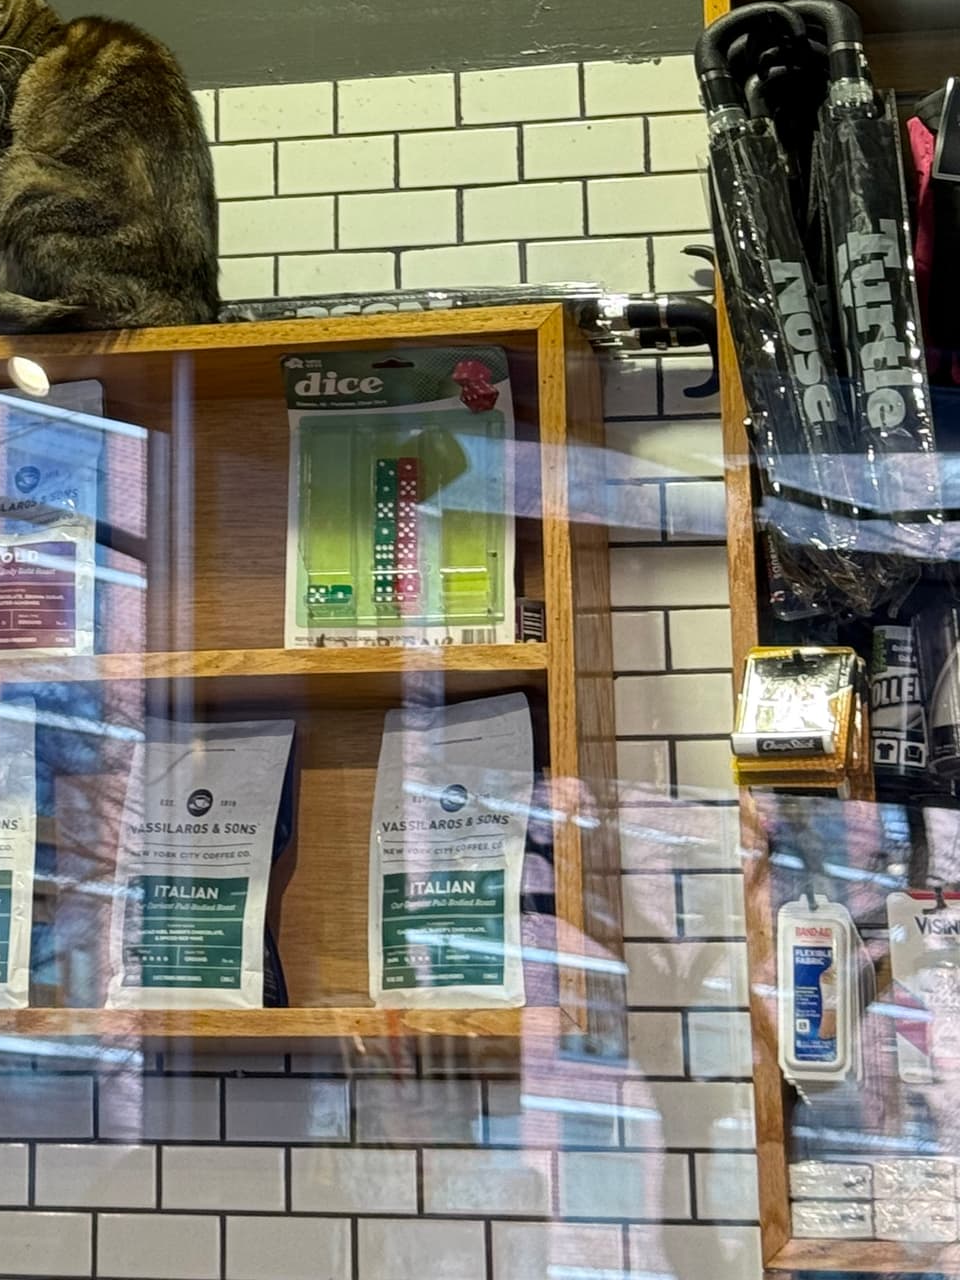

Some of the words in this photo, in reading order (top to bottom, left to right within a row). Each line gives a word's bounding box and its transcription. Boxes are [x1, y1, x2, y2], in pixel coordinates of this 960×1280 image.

[294, 371, 384, 396] dice
[129, 822, 208, 834] VASSILAROS
[212, 823, 220, 834] &
[224, 823, 257, 835] SONS
[382, 818, 462, 832] VASSILAROS
[465, 817, 474, 826] &
[476, 815, 510, 826] SONS
[154, 884, 219, 900] ITALIAN
[410, 880, 476, 896] ITALIAN
[795, 926, 832, 938] BAND-AID
[795, 957, 824, 965] FABRIC
